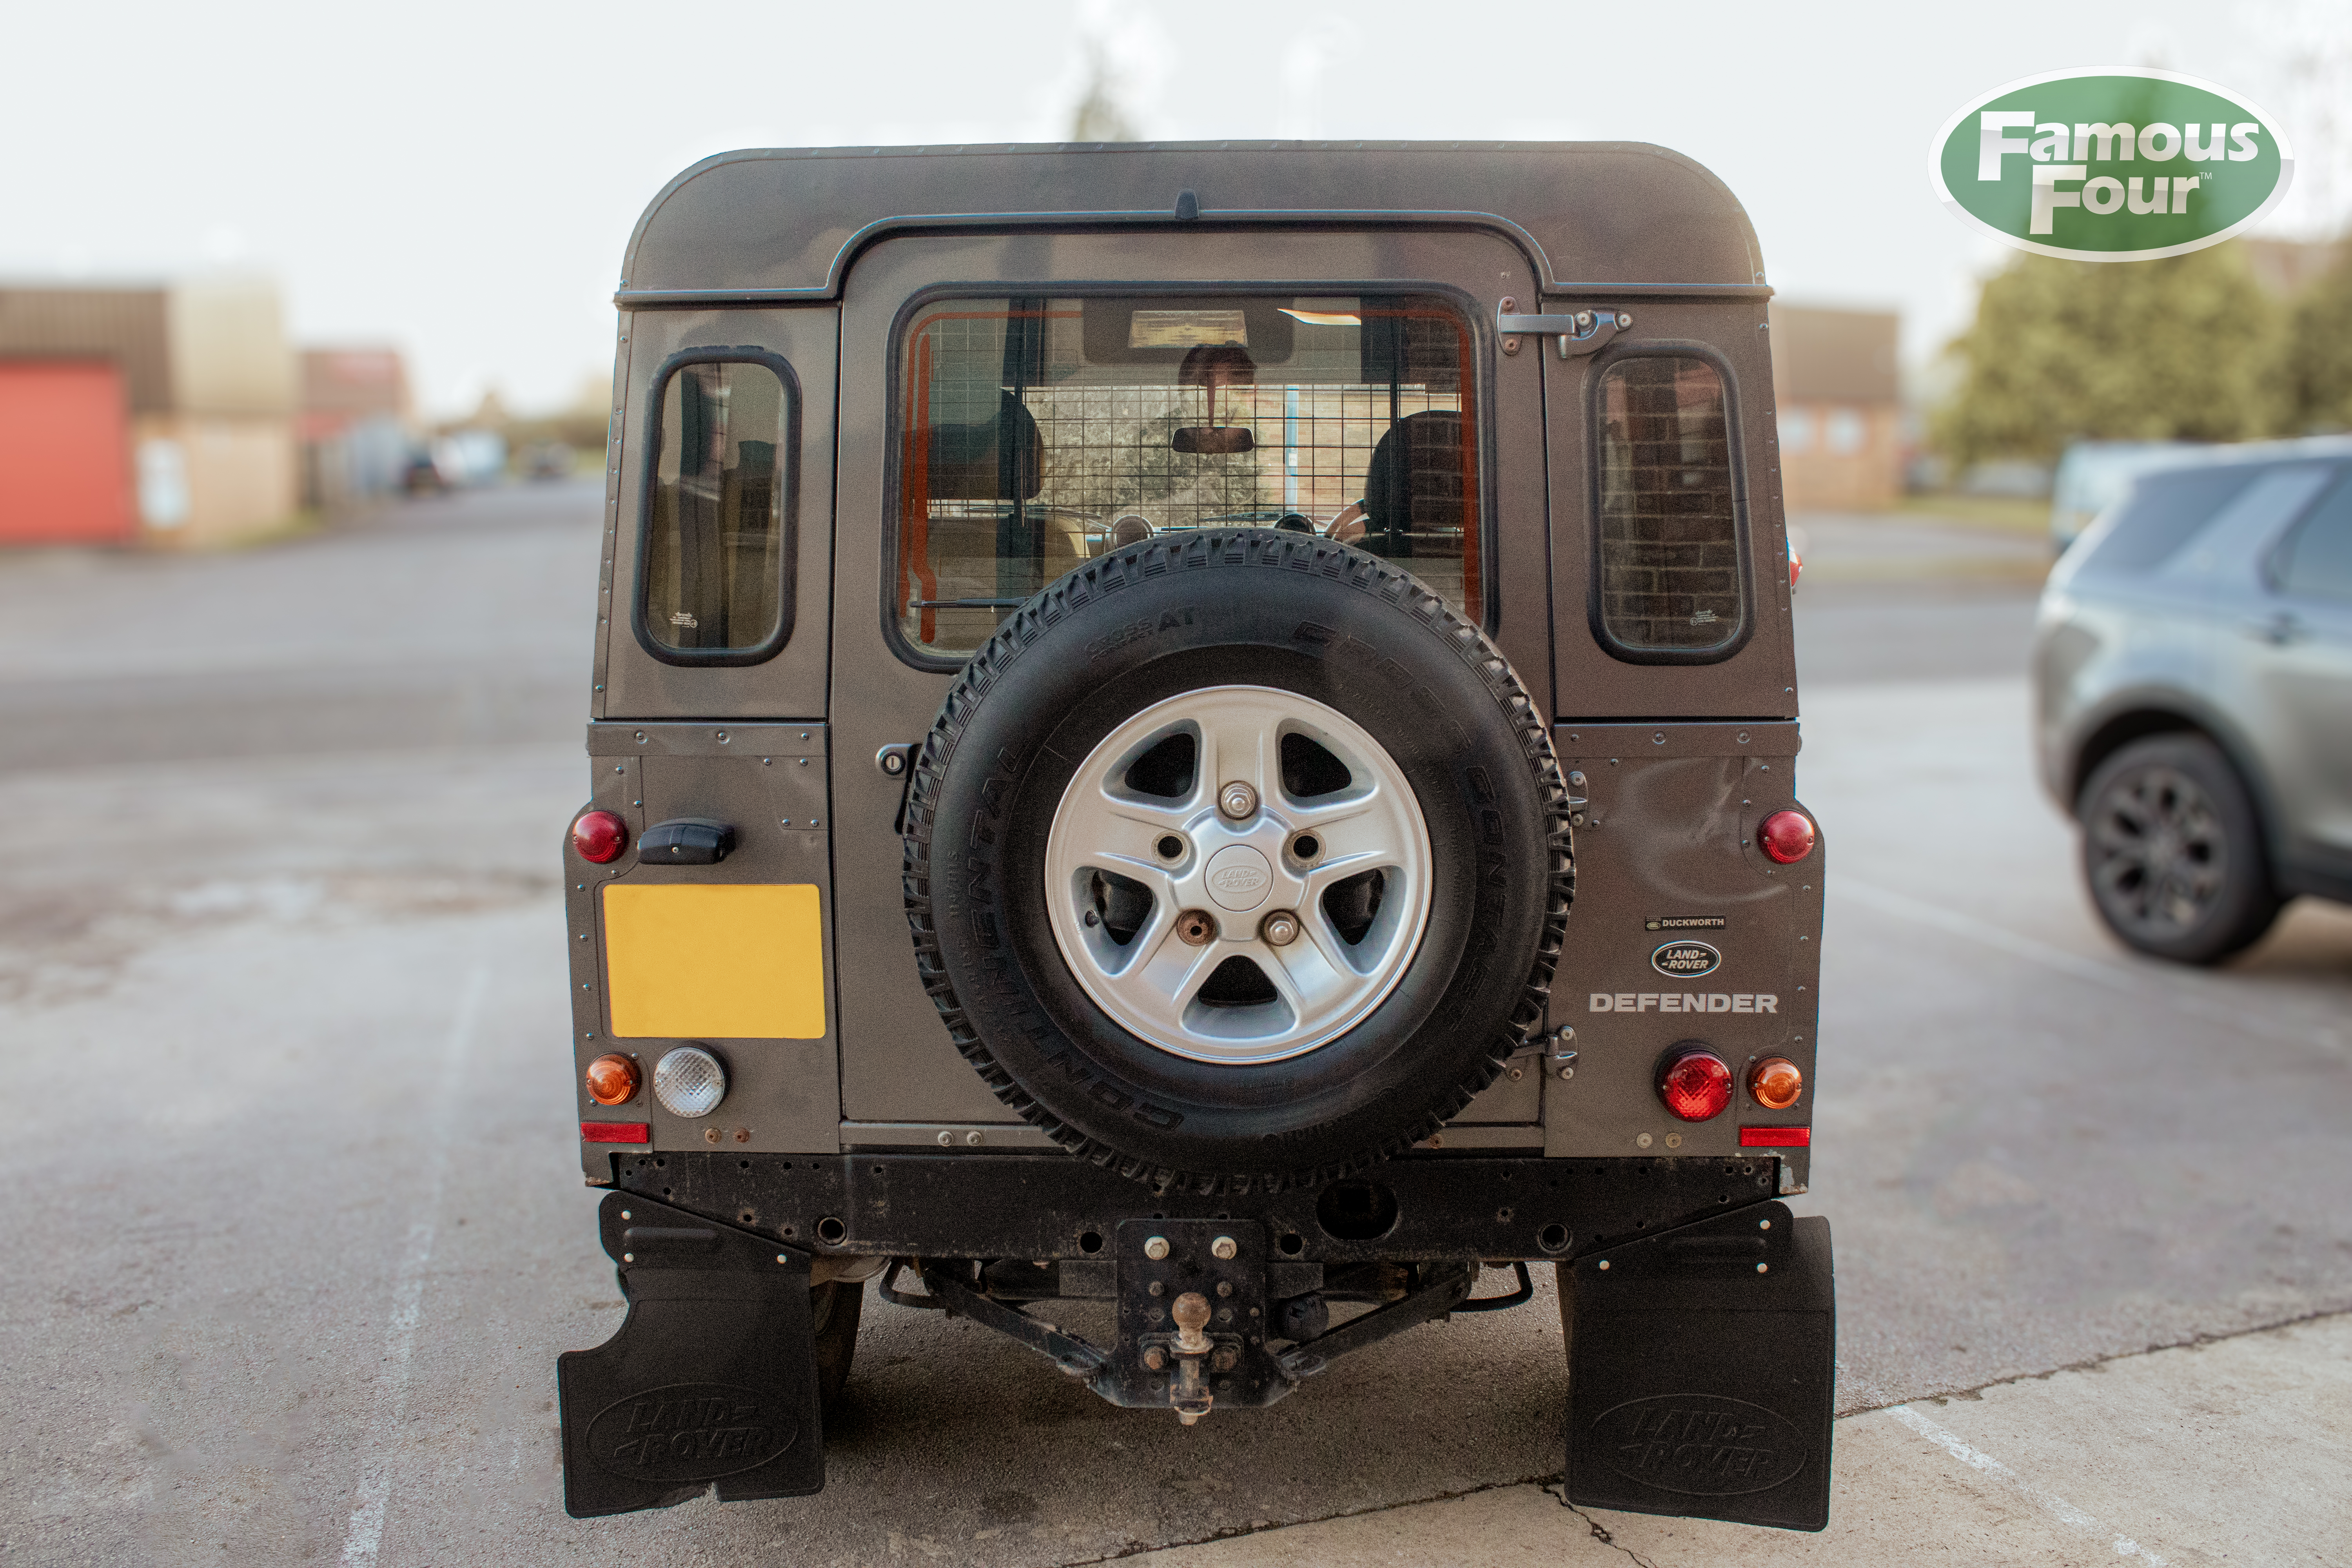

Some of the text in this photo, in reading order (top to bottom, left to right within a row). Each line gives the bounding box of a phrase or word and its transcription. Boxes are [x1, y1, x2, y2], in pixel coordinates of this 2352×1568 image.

[1662, 918, 1724, 927] DUCKWORTH
[1668, 960, 1708, 969] ROVER
[1589, 993, 1779, 1013] DEFENDER
